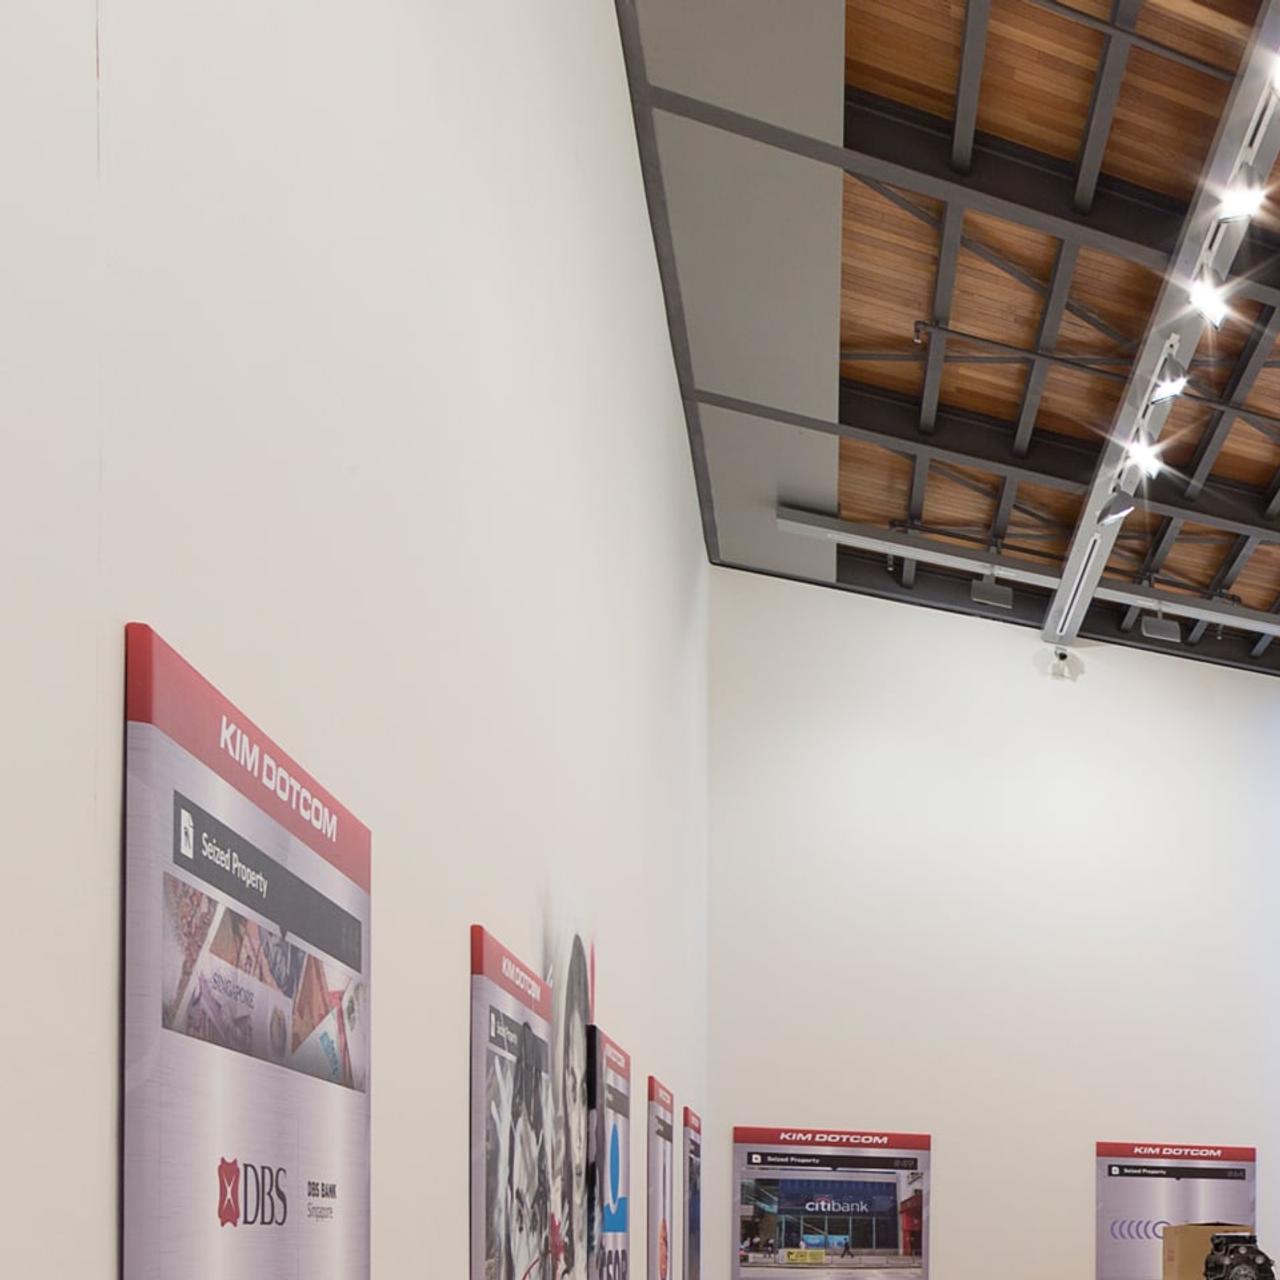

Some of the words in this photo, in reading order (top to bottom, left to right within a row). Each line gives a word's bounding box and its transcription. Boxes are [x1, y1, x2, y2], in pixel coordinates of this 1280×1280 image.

[219, 715, 259, 778] KIM
[263, 752, 338, 843] DOTCOM
[202, 831, 231, 876] Seized
[231, 850, 269, 899] Property
[779, 1132, 813, 1142] KIM
[814, 1134, 889, 1145] DOTCOM
[1134, 1147, 1160, 1155] KIM
[1162, 1148, 1222, 1157] DOTCOM
[242, 1163, 287, 1226] DBS
[307, 1181, 319, 1198] DBS
[321, 1182, 336, 1199] BANK
[805, 1198, 869, 1214] citibank
